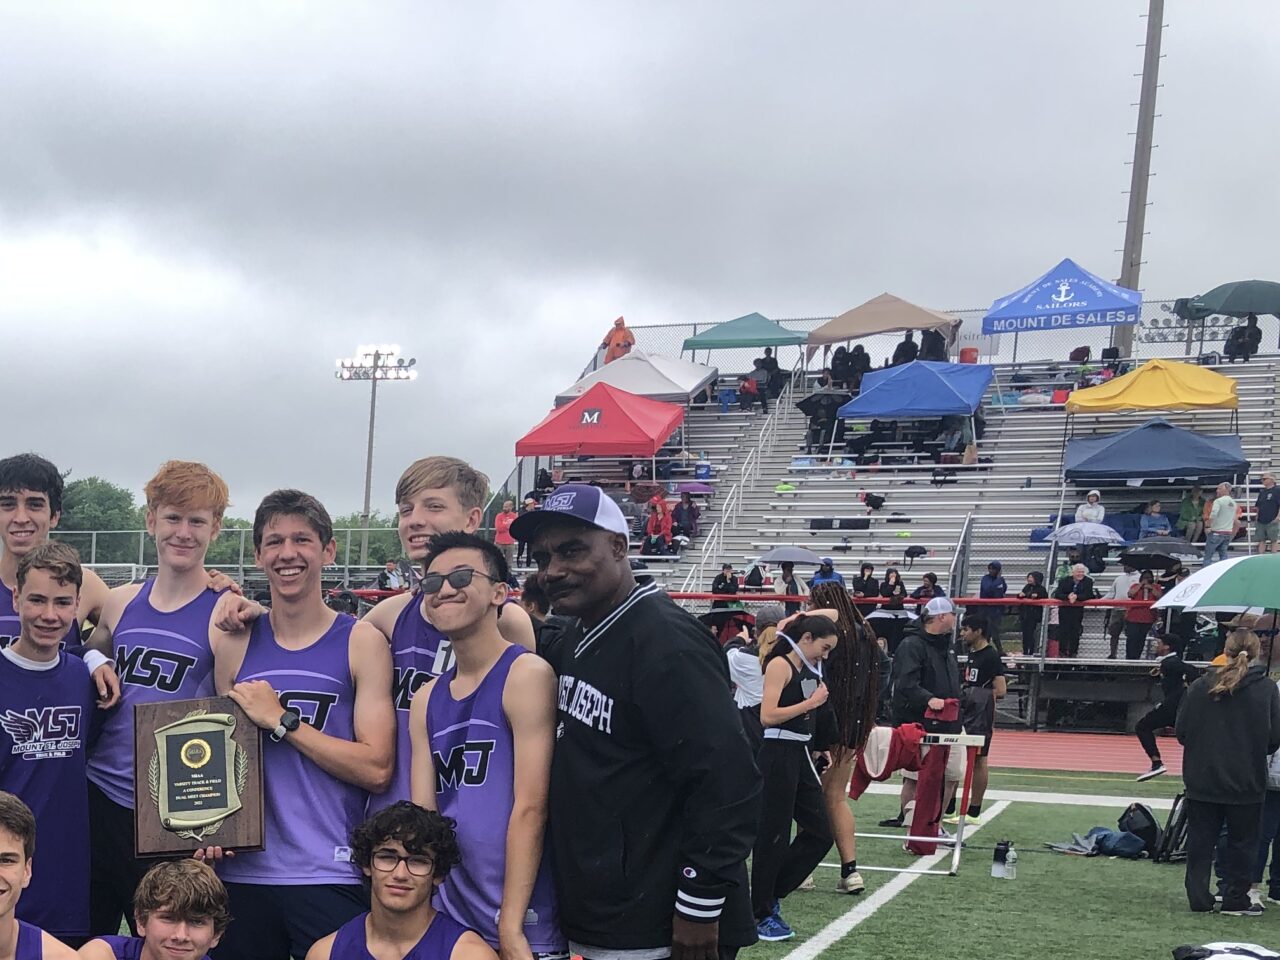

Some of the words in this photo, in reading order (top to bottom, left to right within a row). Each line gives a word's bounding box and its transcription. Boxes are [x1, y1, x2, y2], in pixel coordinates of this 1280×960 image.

[1036, 300, 1088, 310] SAILORS
[993, 316, 1048, 331] MOUNT
[1051, 314, 1072, 326] DE
[1076, 310, 1126, 324] SALES
[581, 411, 600, 424] M
[116, 644, 198, 694] MSJ
[568, 680, 614, 734] JOSEPH
[25, 706, 82, 741] MSJ
[12, 742, 44, 754] MOUNT
